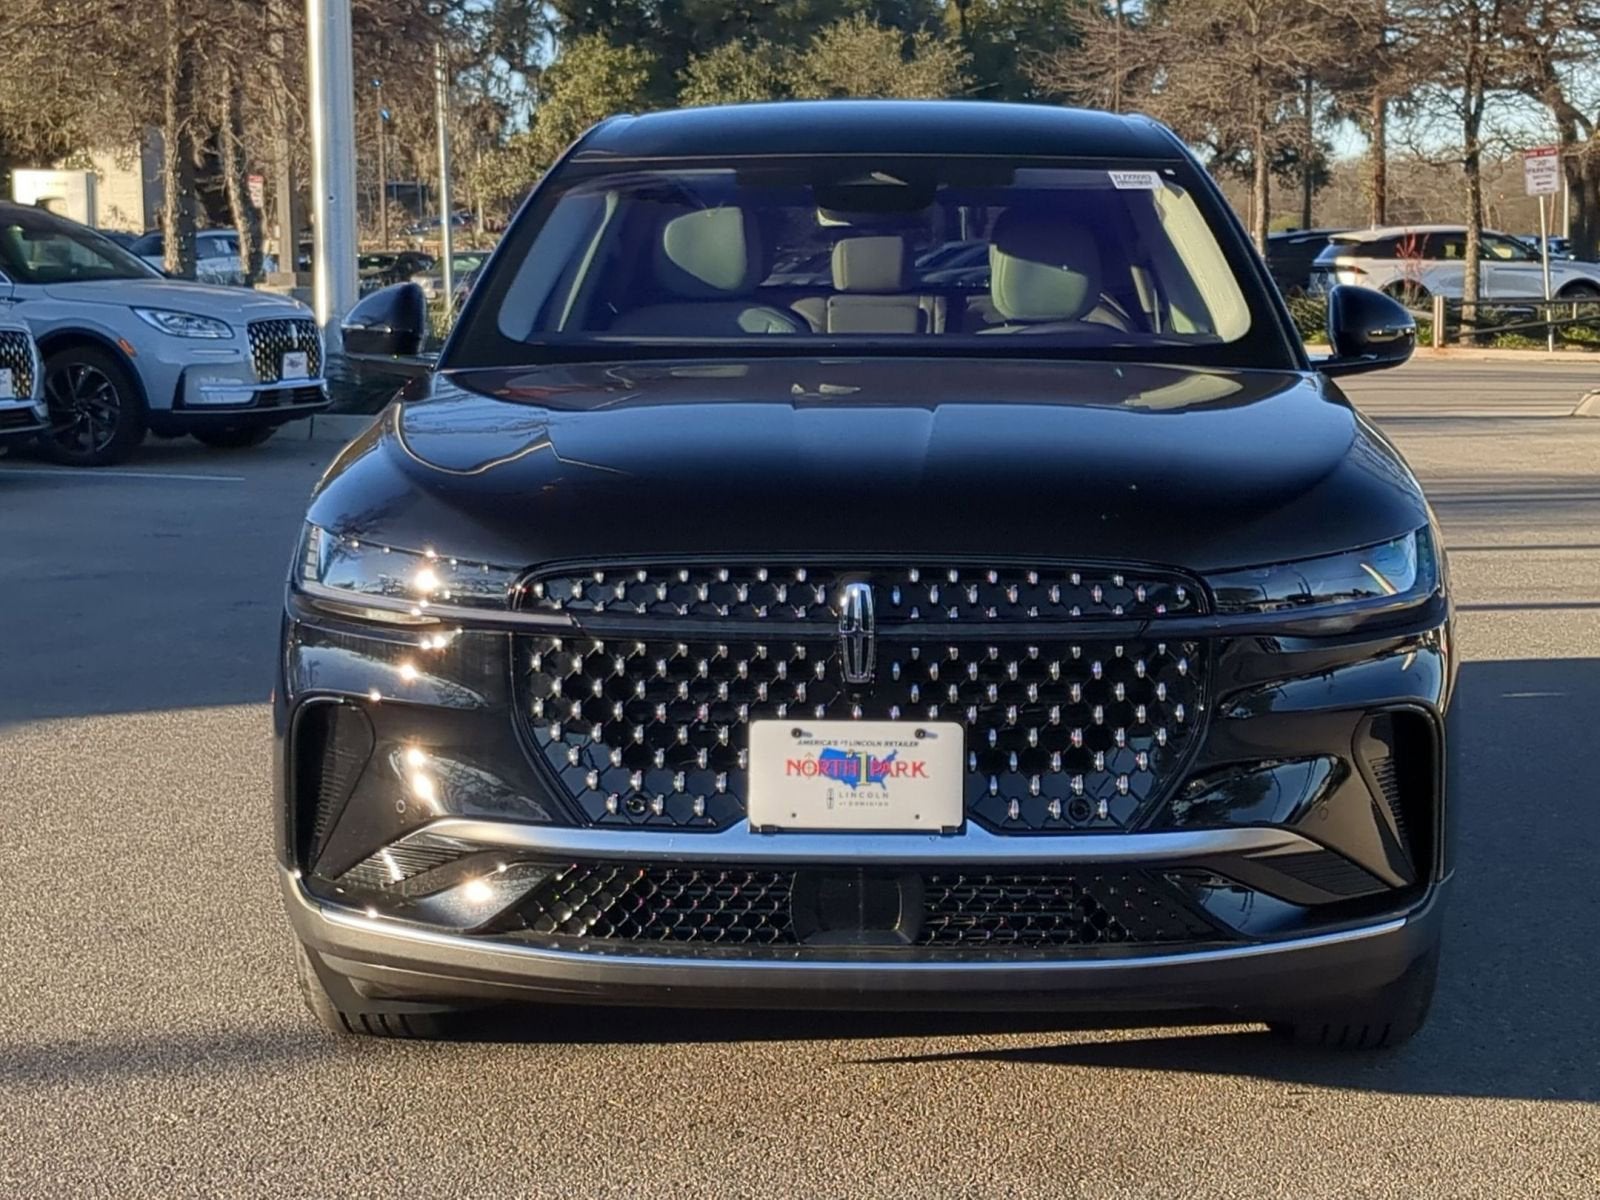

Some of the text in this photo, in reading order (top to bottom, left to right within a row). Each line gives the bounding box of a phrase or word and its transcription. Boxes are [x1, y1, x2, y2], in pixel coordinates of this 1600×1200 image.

[786, 759, 858, 777] NORTH
[870, 760, 929, 778] PARK
[838, 791, 889, 799] LINCOLN
